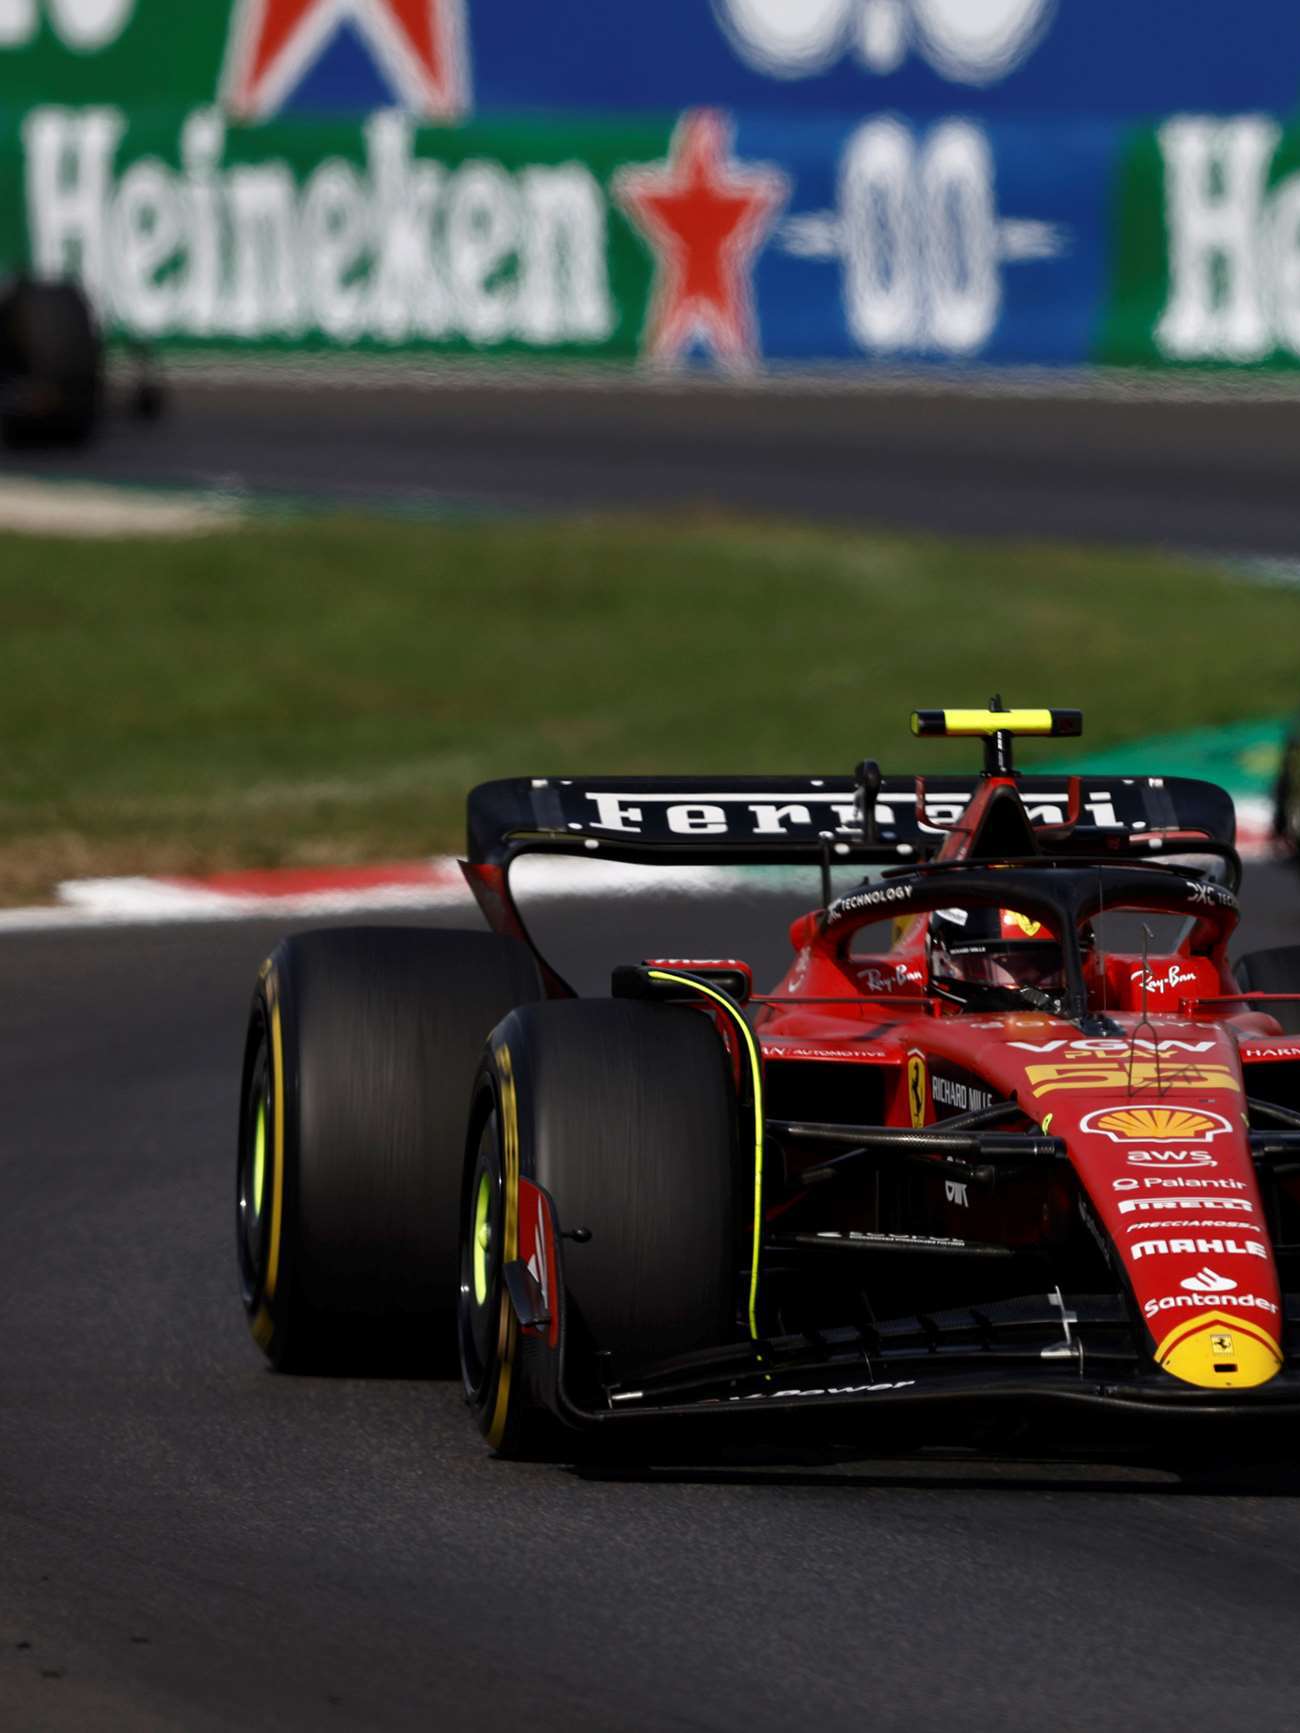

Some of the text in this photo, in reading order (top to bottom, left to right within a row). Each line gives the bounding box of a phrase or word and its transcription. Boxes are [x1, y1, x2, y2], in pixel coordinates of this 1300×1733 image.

[22, 105, 612, 342] Heineken
[841, 885, 913, 912] TECHNOLOGY
[1130, 965, 1197, 994] Ray-Ban
[1006, 1039, 1217, 1053] VGW
[1063, 1050, 1179, 1060] PLAY
[1024, 1062, 1242, 1099] 55
[932, 1075, 967, 1110] RICHARD
[1127, 1150, 1213, 1162] aws
[1143, 1177, 1247, 1190] Palantir
[1118, 1197, 1254, 1215] PIRELLI
[1126, 1219, 1261, 1233] FRECCIAROSSA
[1130, 1238, 1268, 1260] MAHLE
[1143, 1292, 1279, 1319] Santander
